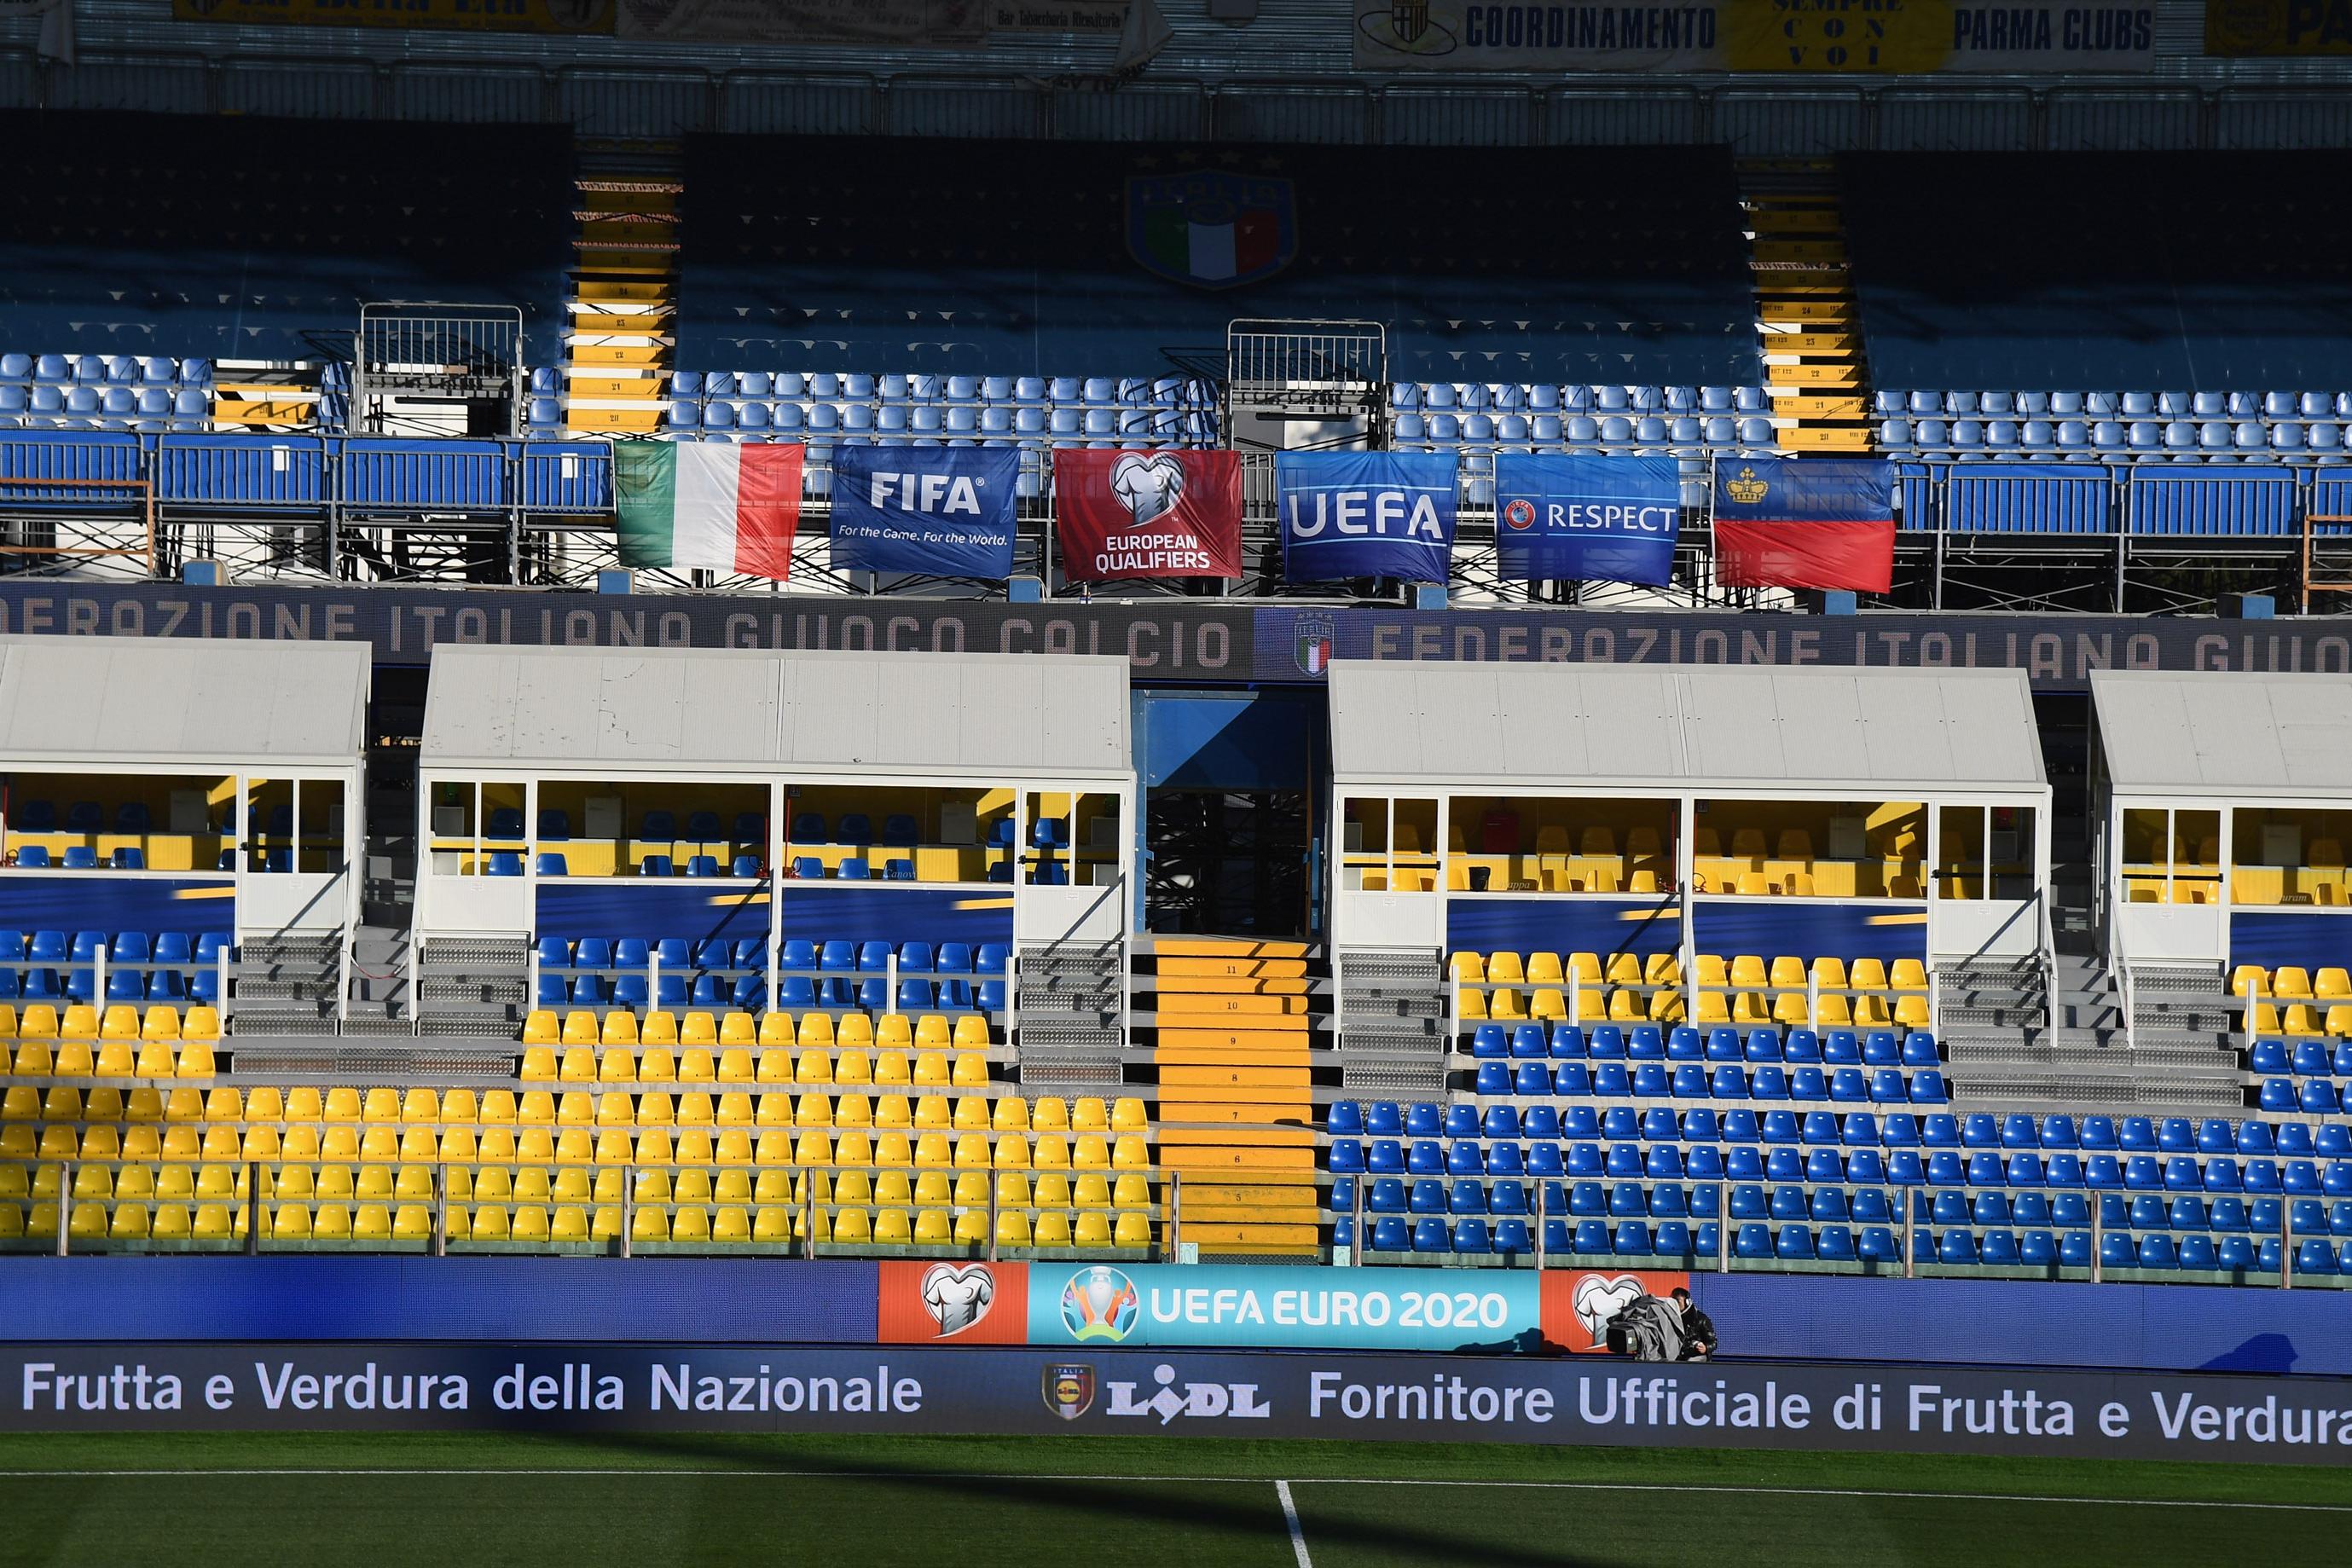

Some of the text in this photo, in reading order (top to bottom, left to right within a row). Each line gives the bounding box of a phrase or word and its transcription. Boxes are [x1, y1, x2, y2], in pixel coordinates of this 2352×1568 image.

[1465, 6, 2152, 50] COORDINAMENTO PARMA CLUBS
[1141, 182, 1277, 200] ITALIA
[615, 350, 624, 359] 22
[871, 472, 982, 515] FIFA
[1288, 490, 1444, 540] UEFA
[1547, 503, 1677, 533] RESPECT
[838, 524, 1008, 546] For the Game. For the World.
[1106, 535, 1198, 552] EUROPEAN
[1095, 552, 1210, 574] QUALIFIERS
[0, 599, 355, 640] ERAZIONE
[390, 606, 692, 651] ITALIANA
[999, 618, 1231, 668] CALCIO
[1372, 624, 1821, 665] FEDERAZIONE
[1856, 631, 2159, 680] ITALIANA
[1226, 965, 1237, 975] 11
[1227, 1001, 1238, 1010] 10
[1230, 1037, 1237, 1045] 9
[1231, 1073, 1238, 1083] 8
[1232, 1111, 1238, 1120] 7
[1234, 1155, 1241, 1164] 6
[1235, 1194, 1242, 1202] 5
[1237, 1232, 1243, 1241] 4
[1150, 1288, 1508, 1328] UEFA EURO 2020
[22, 1363, 182, 1410] Frutta
[205, 1374, 235, 1409] e
[255, 1363, 468, 1410] Verdura
[492, 1363, 624, 1410] della
[651, 1364, 923, 1412] Nazionale
[1309, 1371, 1555, 1422] Fornitore
[1579, 1376, 1811, 1429] Ufficiale
[1833, 1383, 1881, 1431] di
[1908, 1384, 2075, 1436] Frutta
[2098, 1401, 2130, 1438] e
